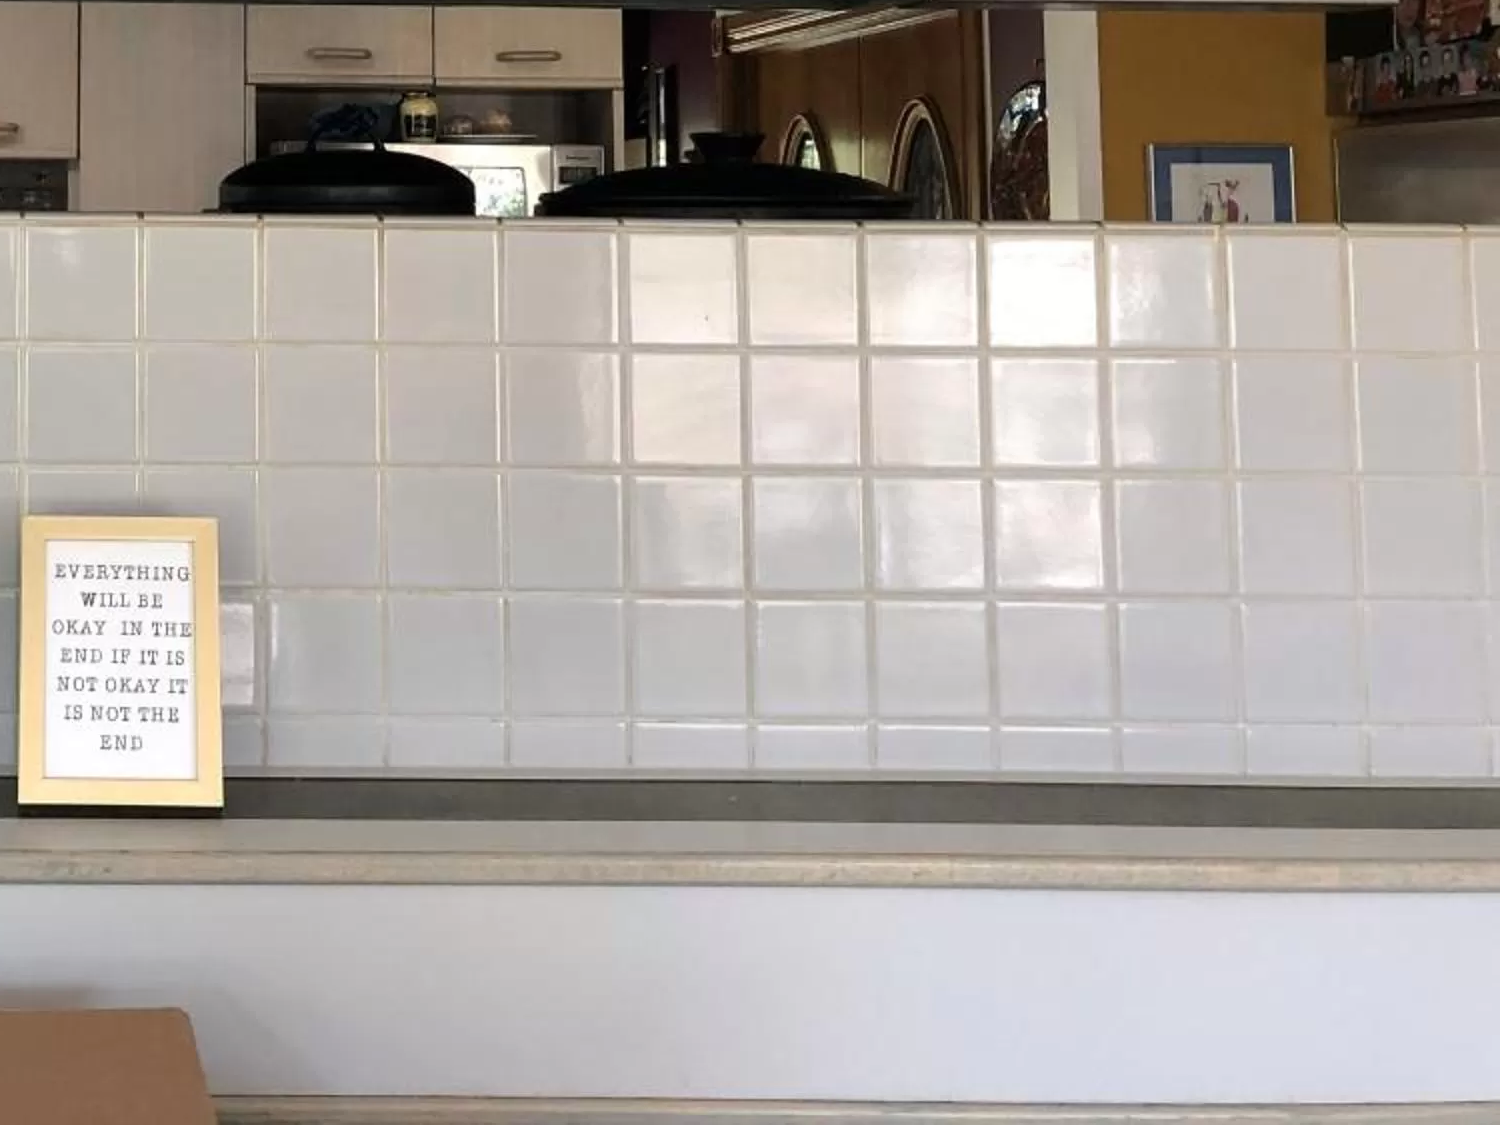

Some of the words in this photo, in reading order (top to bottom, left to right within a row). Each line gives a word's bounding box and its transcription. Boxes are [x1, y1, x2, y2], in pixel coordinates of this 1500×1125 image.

[55, 564, 191, 582] EVERYTHING
[81, 592, 130, 608] WILL
[138, 594, 163, 609] BE
[52, 620, 106, 635] OKAY
[121, 621, 143, 636] IN
[151, 622, 193, 638] THE
[60, 649, 103, 664] END
[111, 649, 131, 664] IF
[140, 650, 158, 665] IT
[167, 651, 185, 666] IS
[57, 677, 98, 692] NOT
[105, 678, 159, 693] OKAY
[168, 679, 188, 694] IT
[64, 705, 83, 721] IS
[91, 706, 132, 722] NOT
[138, 707, 179, 723] THE
[100, 735, 143, 751] END
